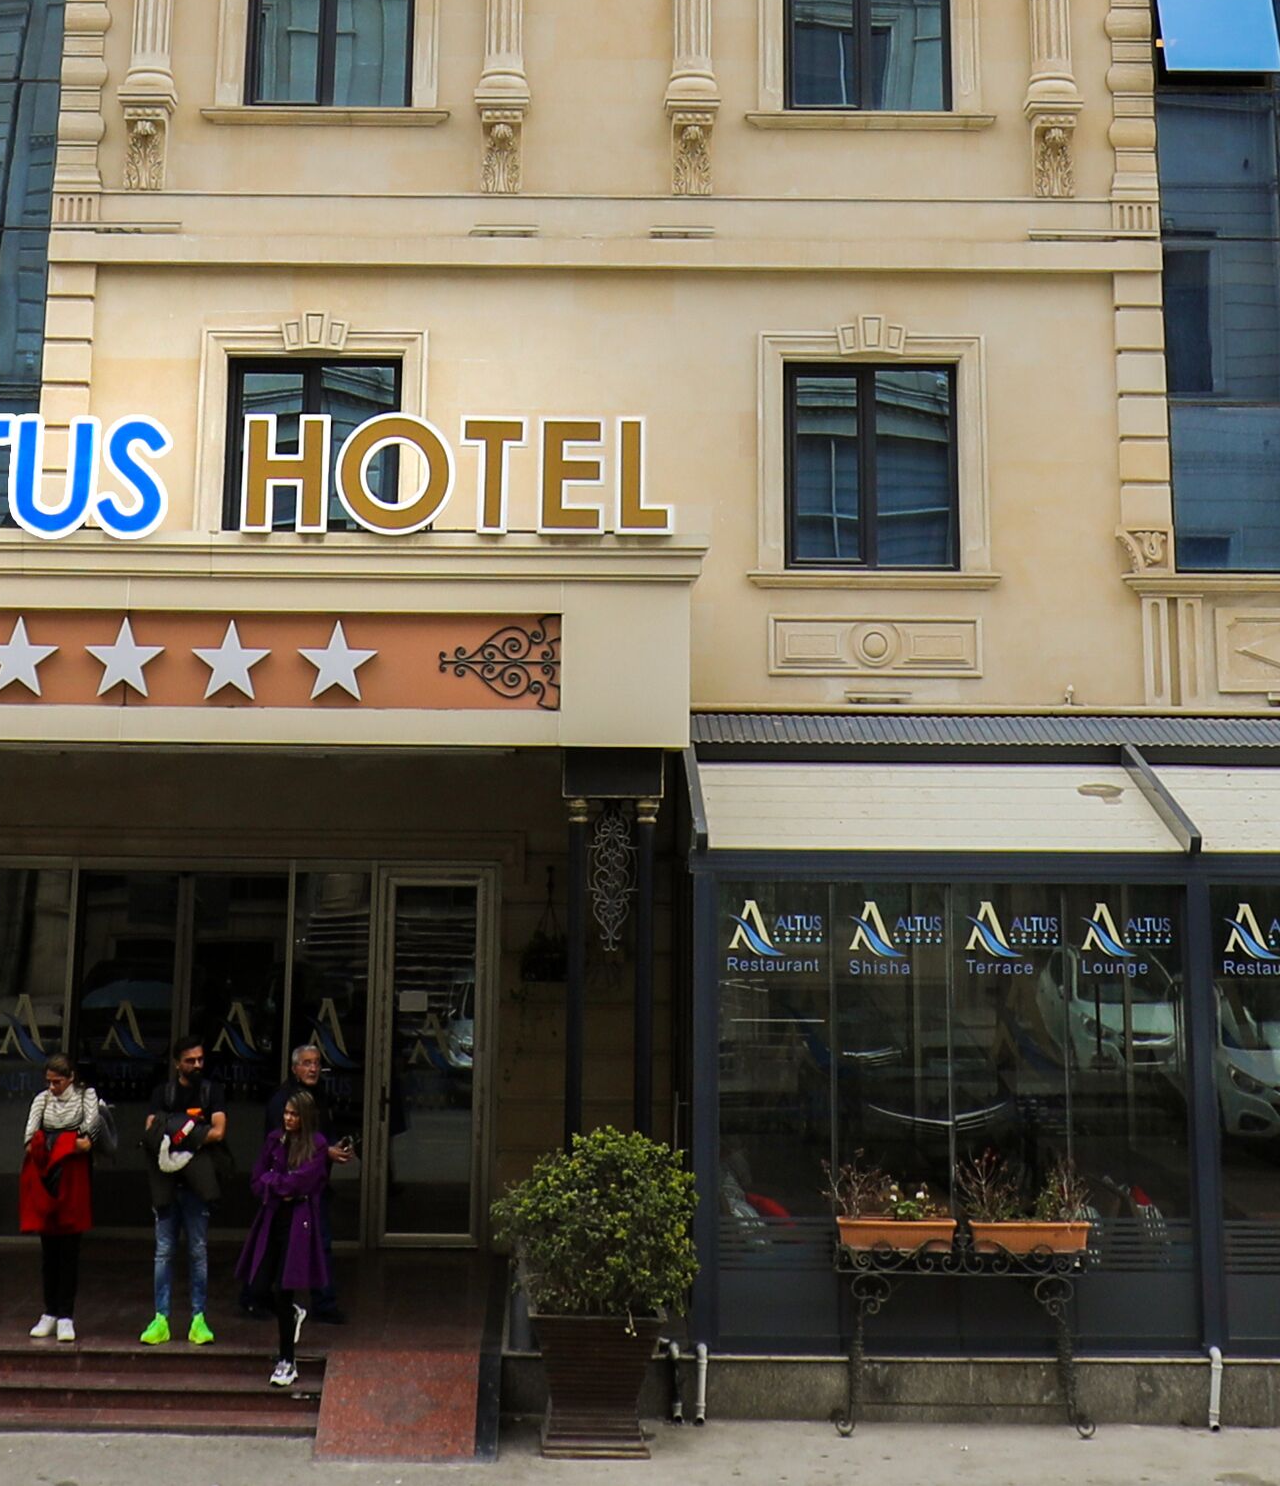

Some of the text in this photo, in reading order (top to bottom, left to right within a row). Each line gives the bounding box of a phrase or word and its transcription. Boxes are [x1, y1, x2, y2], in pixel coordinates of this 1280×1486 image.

[240, 412, 675, 536] HOTEL
[775, 915, 822, 931] ALTUS
[894, 916, 942, 932] ALTUS
[1011, 917, 1059, 932] ALTUS
[1125, 917, 1171, 932] ALTUS
[727, 957, 820, 972] Restaurant
[849, 960, 911, 975] Shisha
[966, 960, 1033, 975] Terrace
[1082, 960, 1149, 978] Lounge
